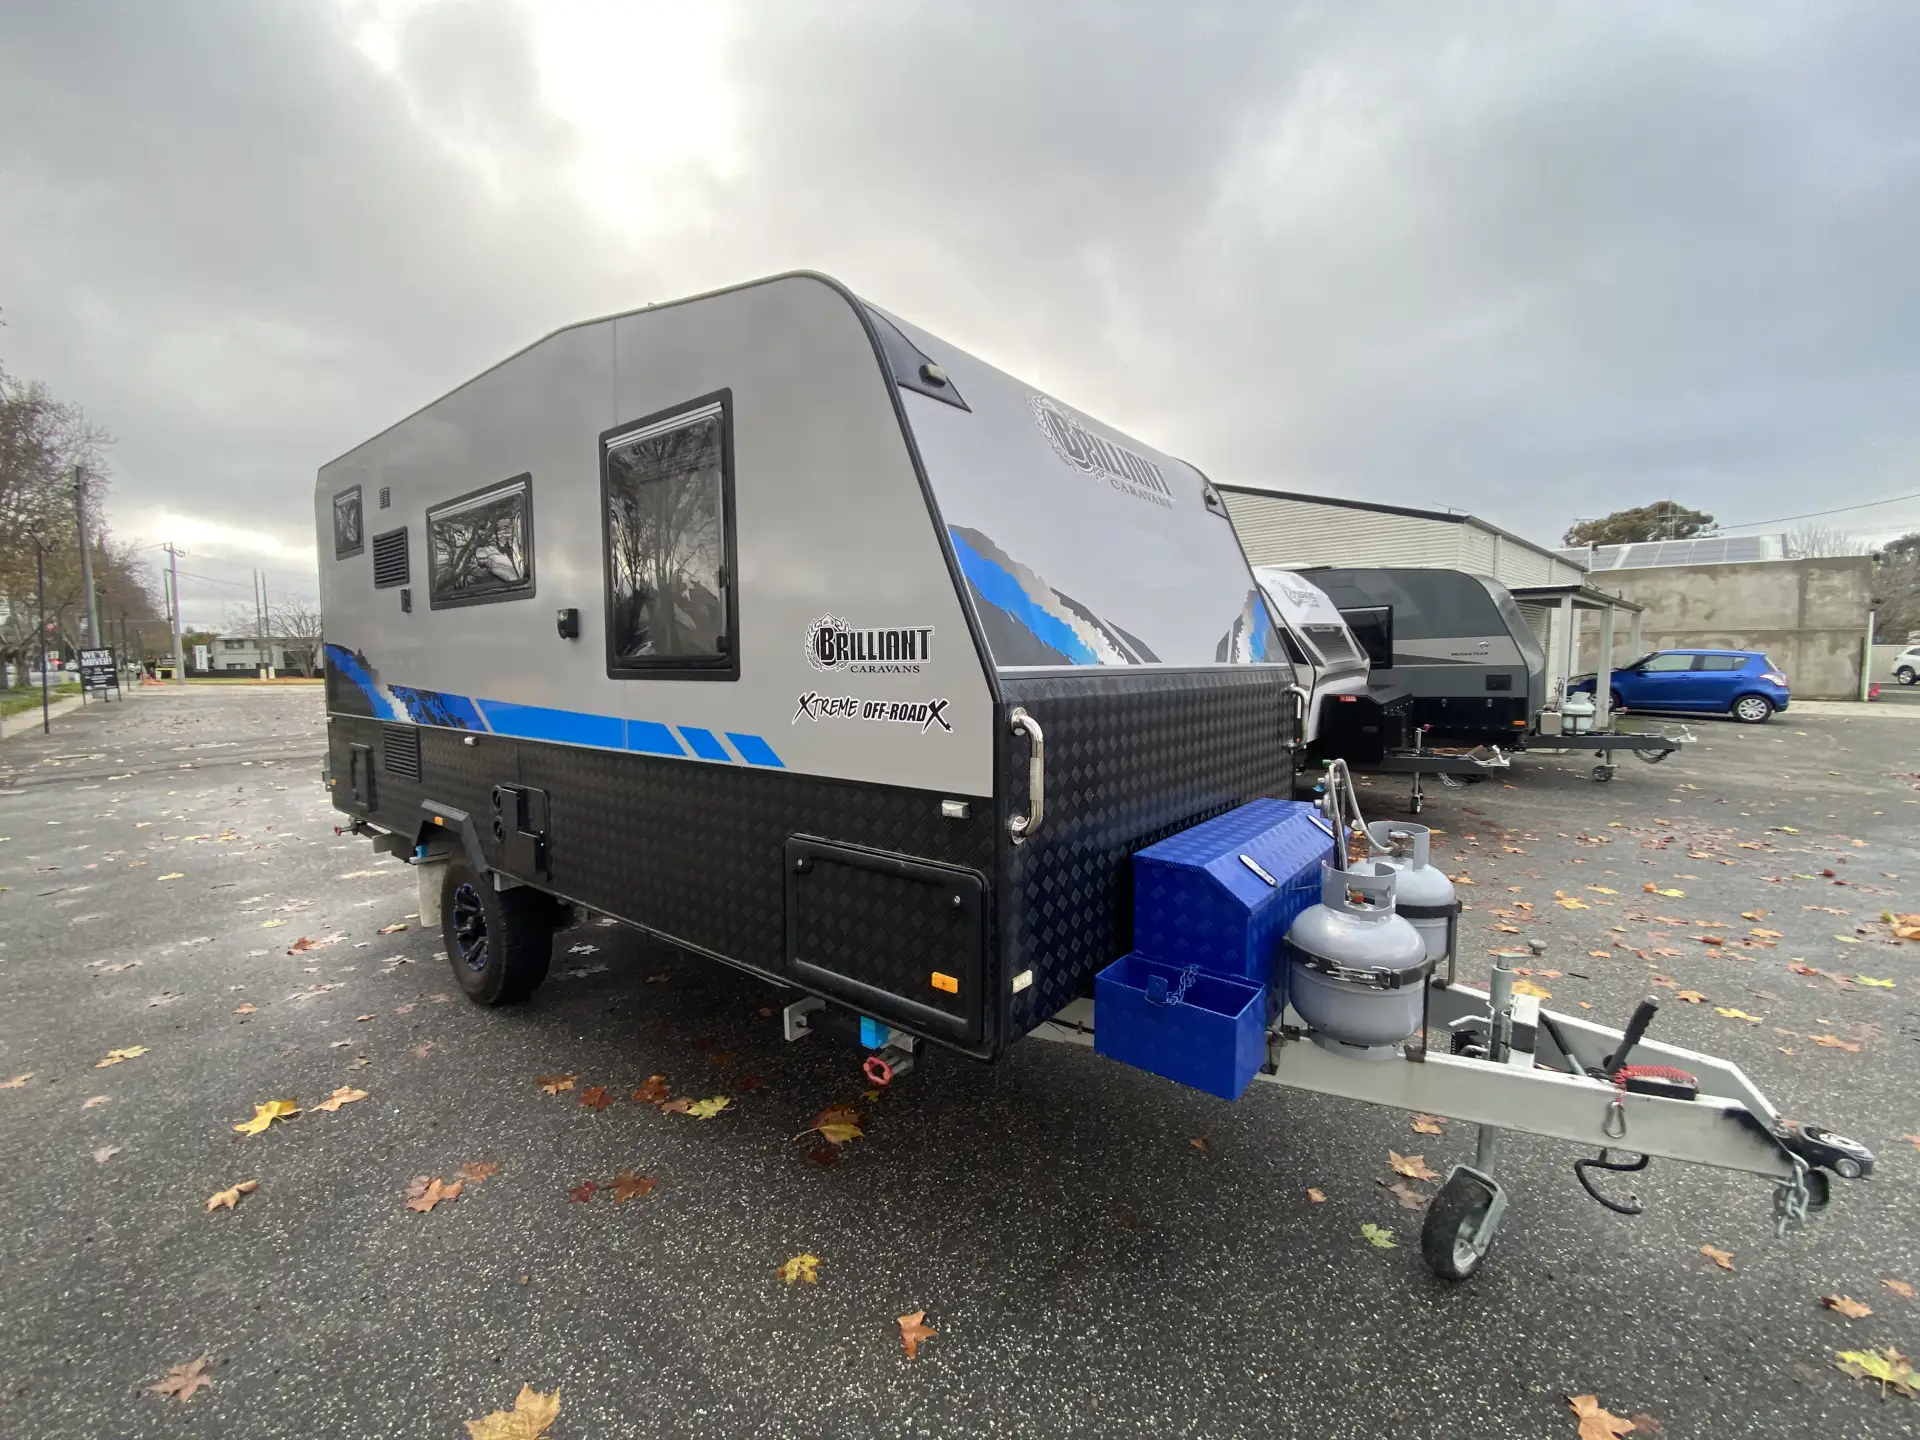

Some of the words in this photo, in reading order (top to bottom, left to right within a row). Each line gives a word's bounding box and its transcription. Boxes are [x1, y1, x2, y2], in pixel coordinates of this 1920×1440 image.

[1047, 409, 1172, 496] BRILLIANT
[1110, 479, 1172, 510] CARAVANS
[819, 627, 932, 661] BRILLIANT
[850, 665, 920, 673] CARAVANS
[793, 692, 859, 724] XTREME
